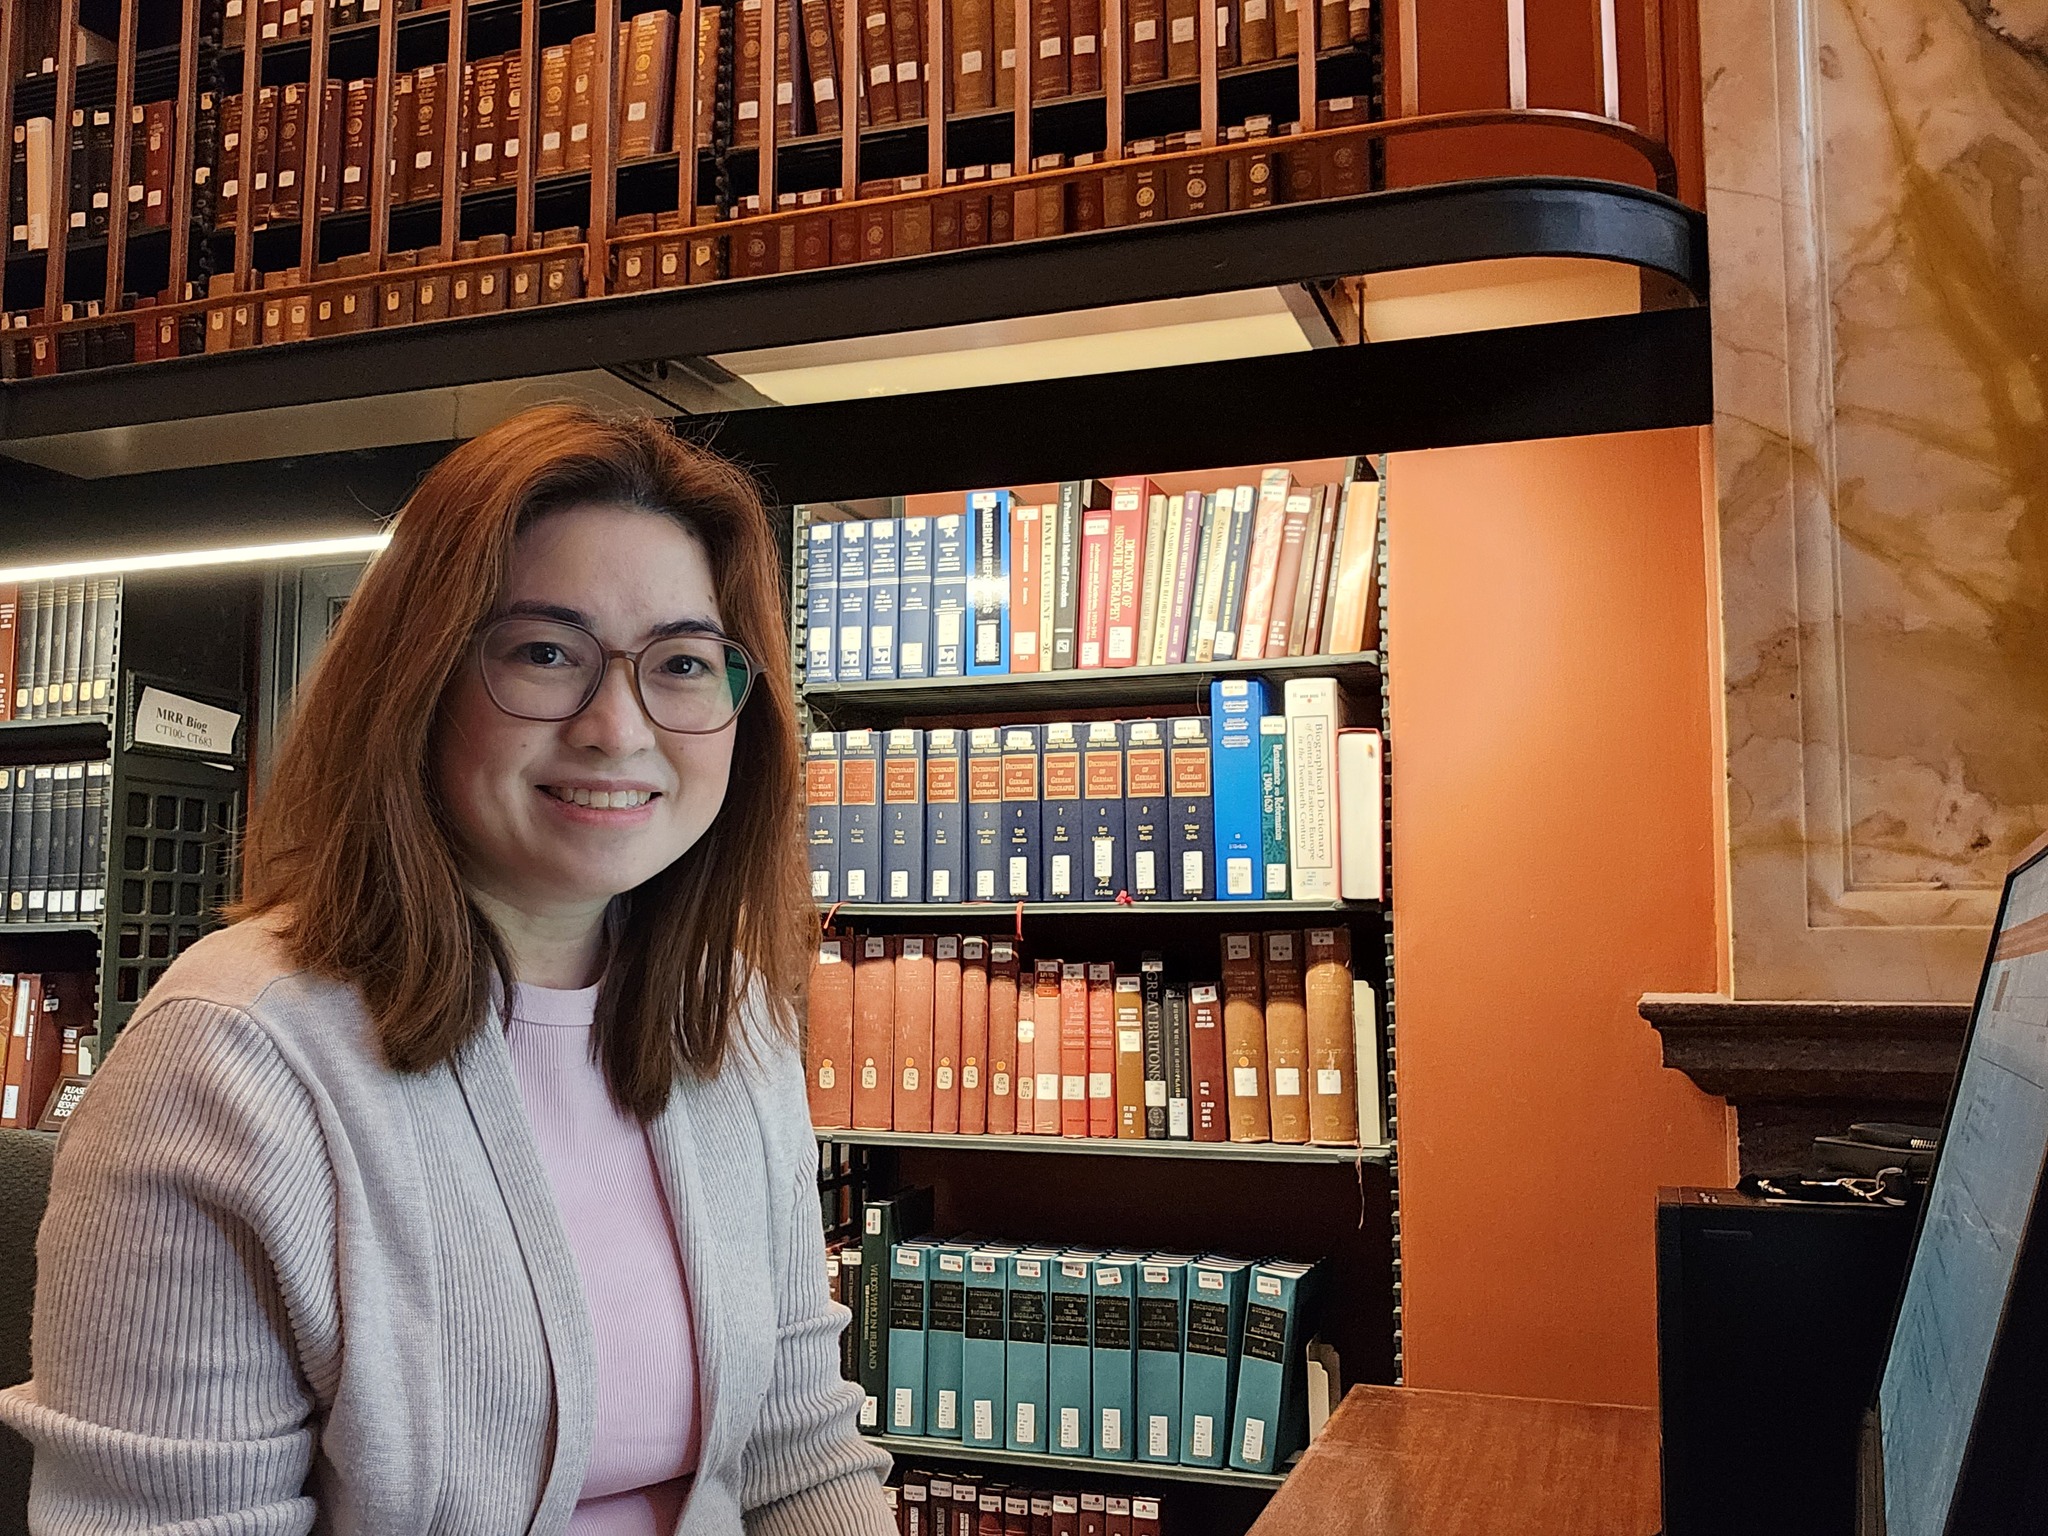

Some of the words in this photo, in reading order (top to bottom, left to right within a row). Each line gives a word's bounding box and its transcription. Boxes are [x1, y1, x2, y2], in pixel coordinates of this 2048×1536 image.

[1064, 486, 1072, 501] The
[982, 507, 993, 556] AMERICAN
[1062, 502, 1071, 542] Presidential
[1182, 522, 1192, 550] CANADIAN
[1061, 543, 1070, 566] Medal
[1112, 525, 1124, 567] MISSOURI
[1061, 566, 1070, 575] of
[1122, 539, 1135, 594] DICTIONARY
[1060, 576, 1070, 608] Freedom
[1110, 569, 1122, 622] BIOGRAPHY
[1121, 595, 1133, 608] OF
[156, 707, 183, 725] MRR
[186, 715, 208, 734] Biog
[187, 733, 213, 747] CT683
[1314, 722, 1325, 794] Biographical
[1274, 797, 1284, 840] Reformation
[1317, 798, 1325, 861] Dictionary
[1146, 972, 1158, 1018] GREAT
[1148, 1021, 1160, 1080] BRITONS
[870, 1294, 878, 1318] WHO
[870, 1319, 877, 1330] IN
[869, 1332, 877, 1369] IRELAND
